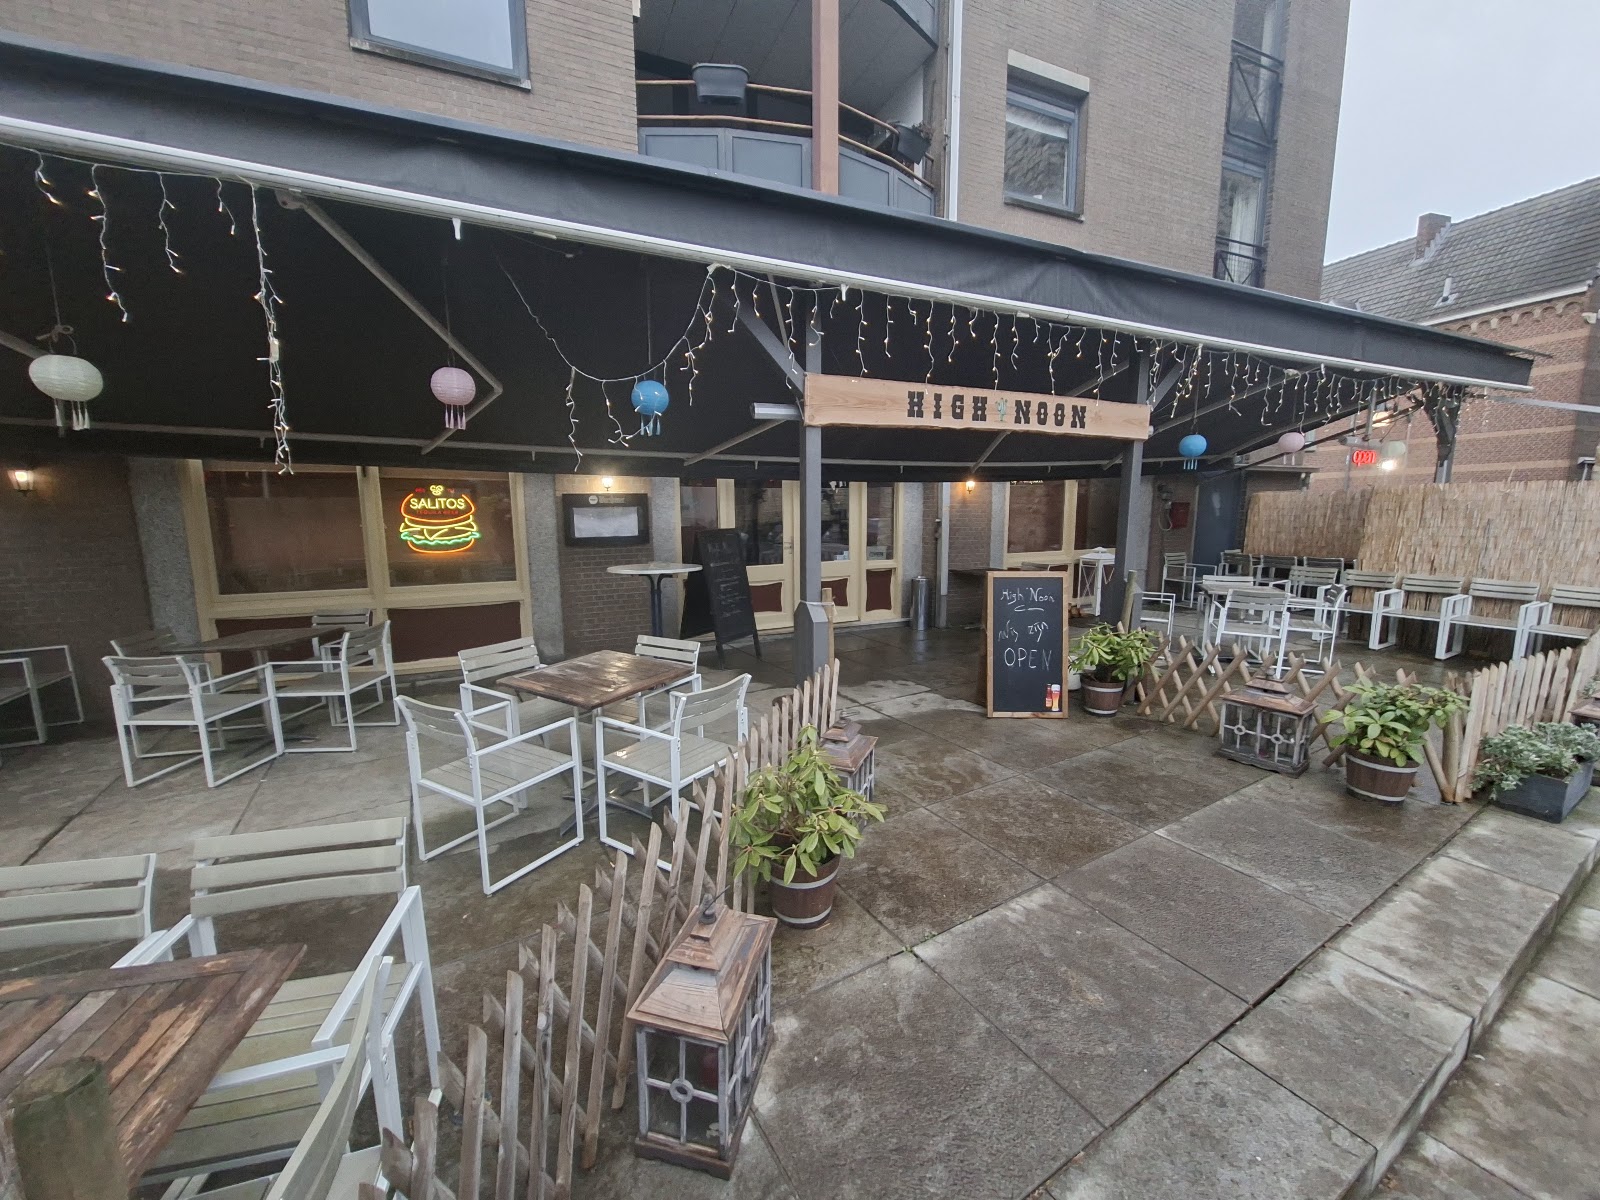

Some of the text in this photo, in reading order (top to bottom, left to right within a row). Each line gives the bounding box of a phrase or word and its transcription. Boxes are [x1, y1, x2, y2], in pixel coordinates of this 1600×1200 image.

[907, 391, 1087, 429] HIGH NOON
[410, 498, 465, 509] SALITOS
[1000, 587, 1055, 605] High Noon
[1004, 647, 1052, 671] OPEN
